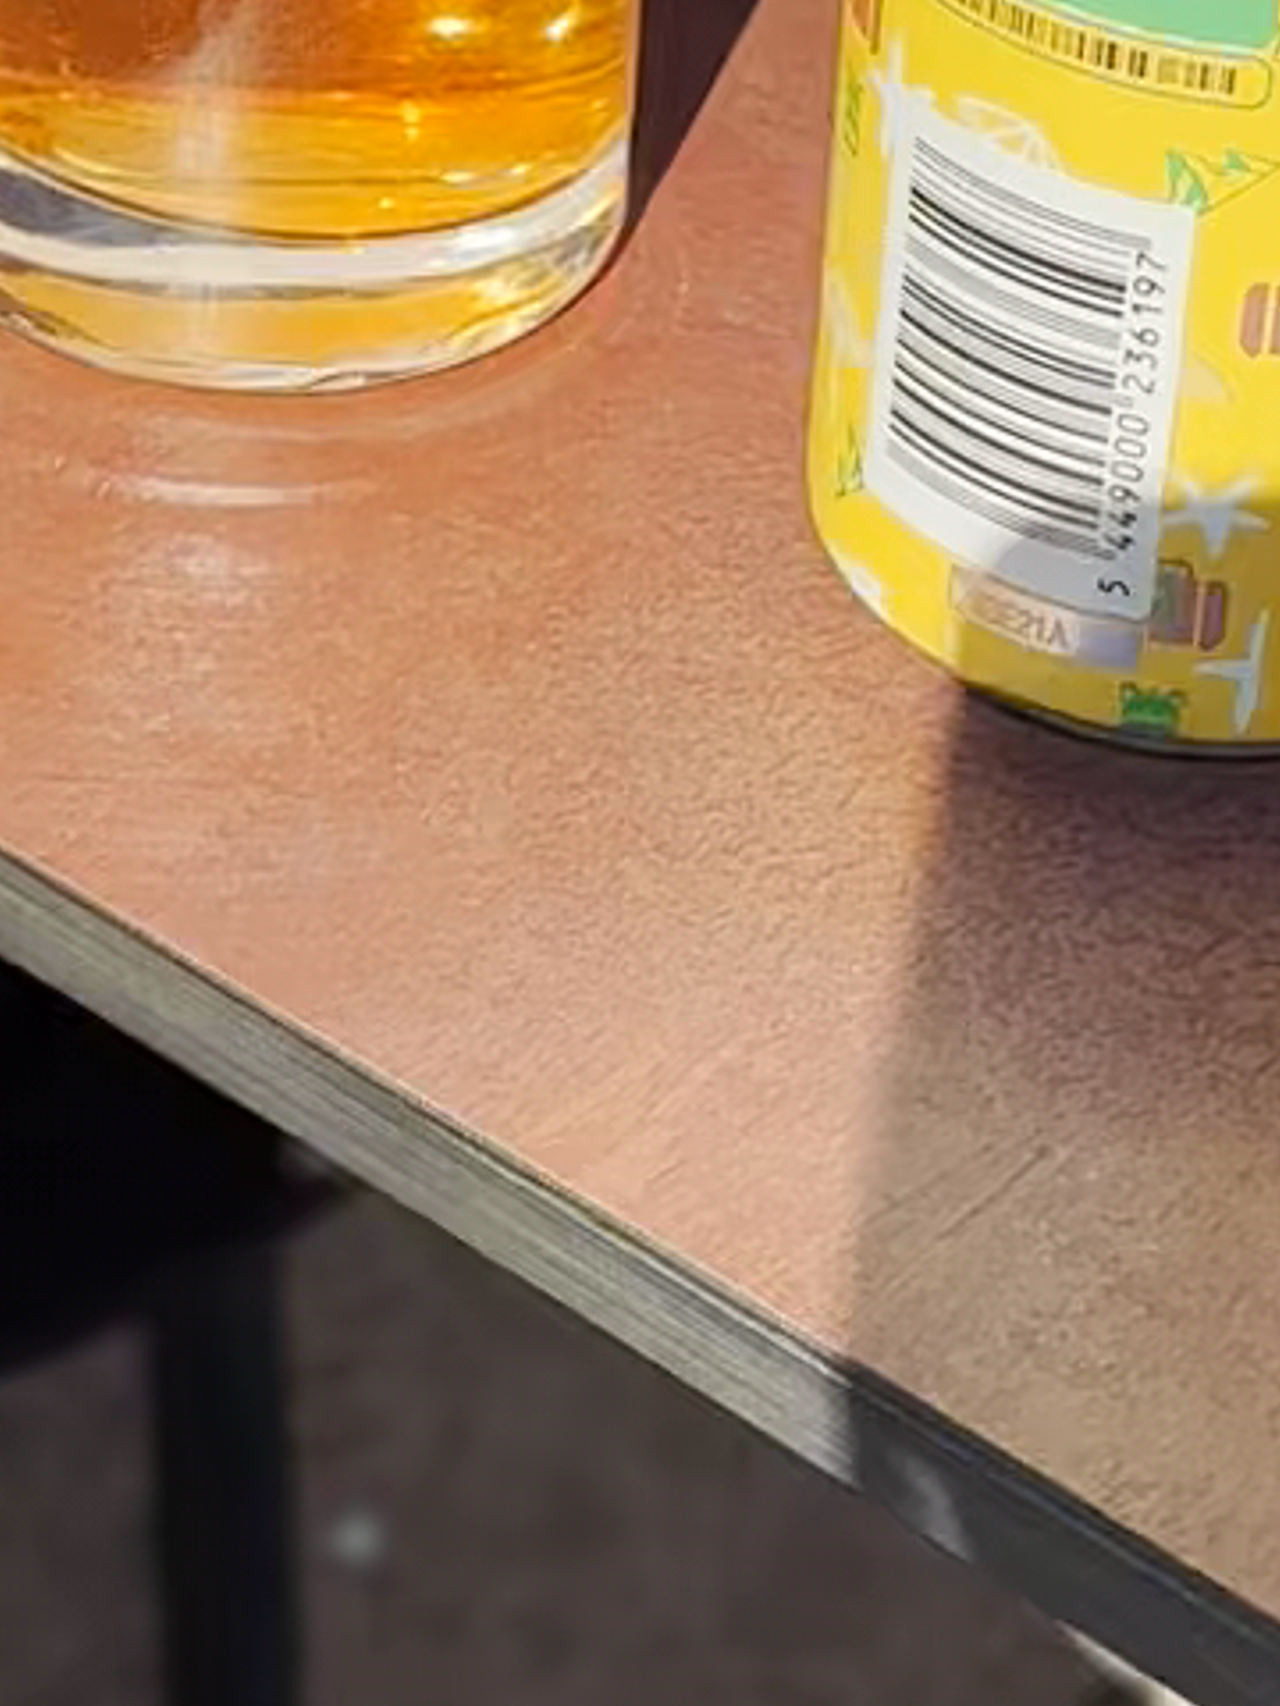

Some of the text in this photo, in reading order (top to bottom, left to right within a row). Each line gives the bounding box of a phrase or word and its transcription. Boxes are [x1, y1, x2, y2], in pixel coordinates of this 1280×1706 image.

[1097, 250, 1168, 598] 5 449000 236197
